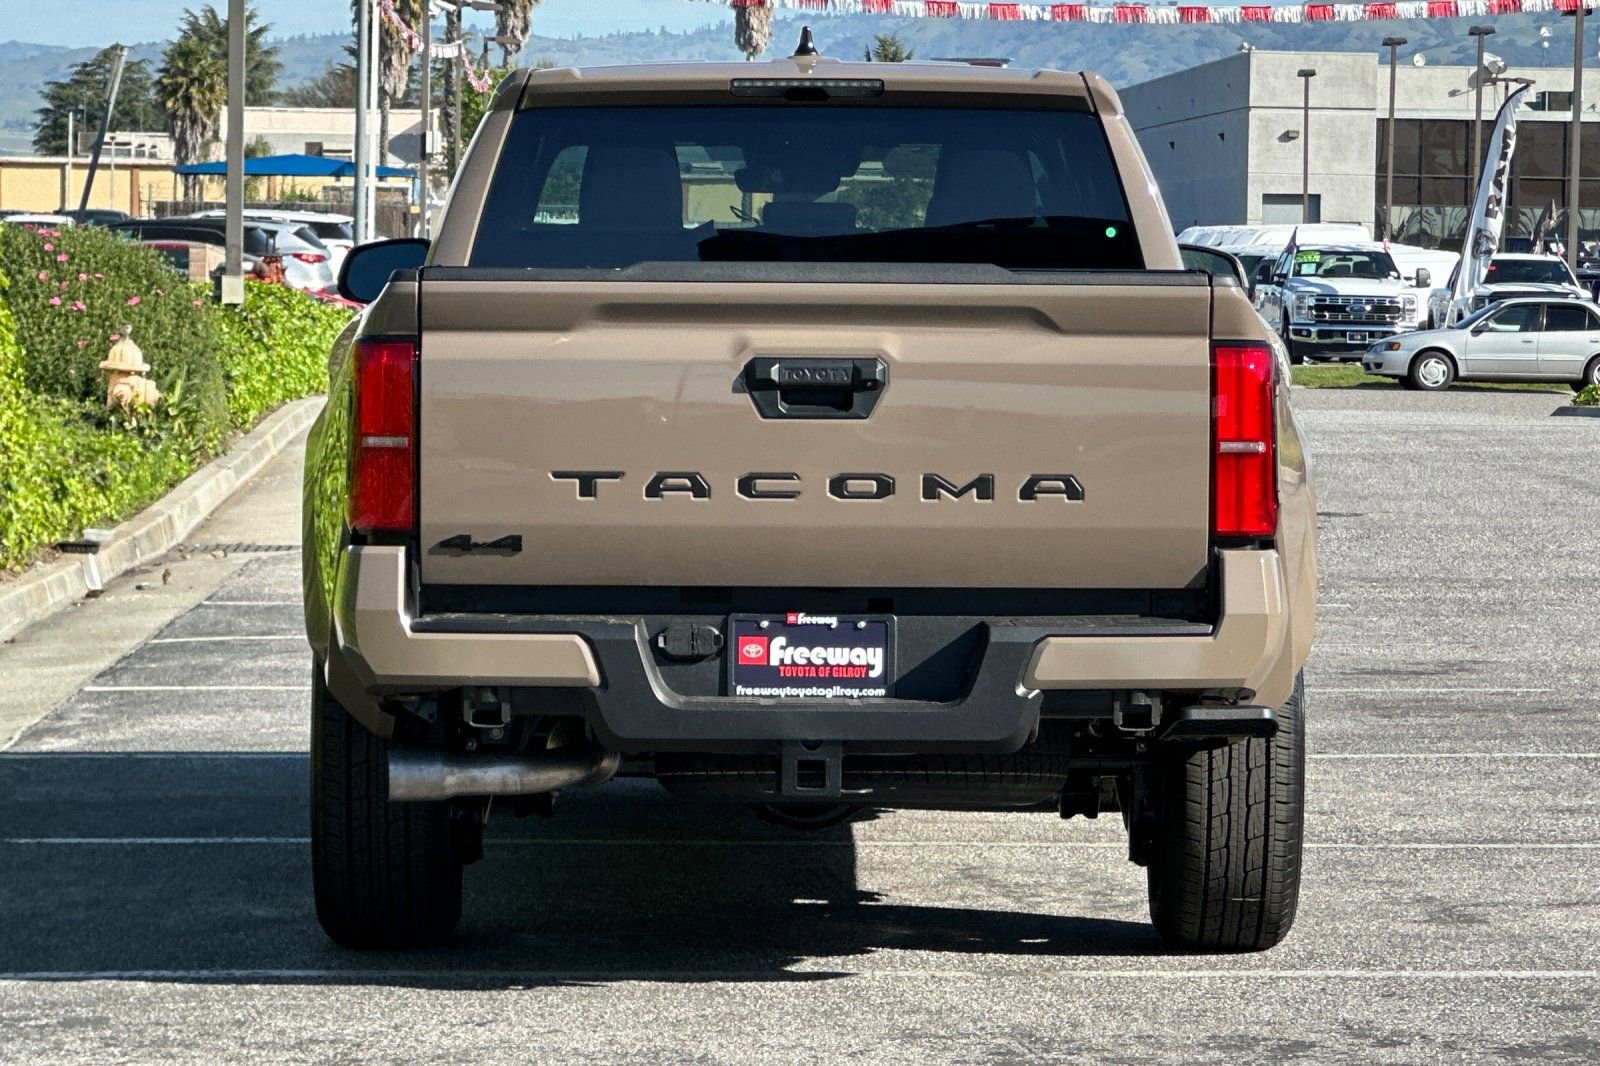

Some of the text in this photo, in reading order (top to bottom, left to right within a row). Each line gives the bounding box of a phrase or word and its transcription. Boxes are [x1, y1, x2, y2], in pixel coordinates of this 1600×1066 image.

[1485, 128, 1514, 219] RAM
[782, 368, 849, 382] TOYOTA
[549, 471, 1085, 502] TACOMA
[797, 612, 838, 628] freeway
[769, 636, 883, 678] freeway
[779, 666, 868, 678] TOYOTA OF GILROY
[736, 685, 886, 698] freewaytoyotagilroy.com
